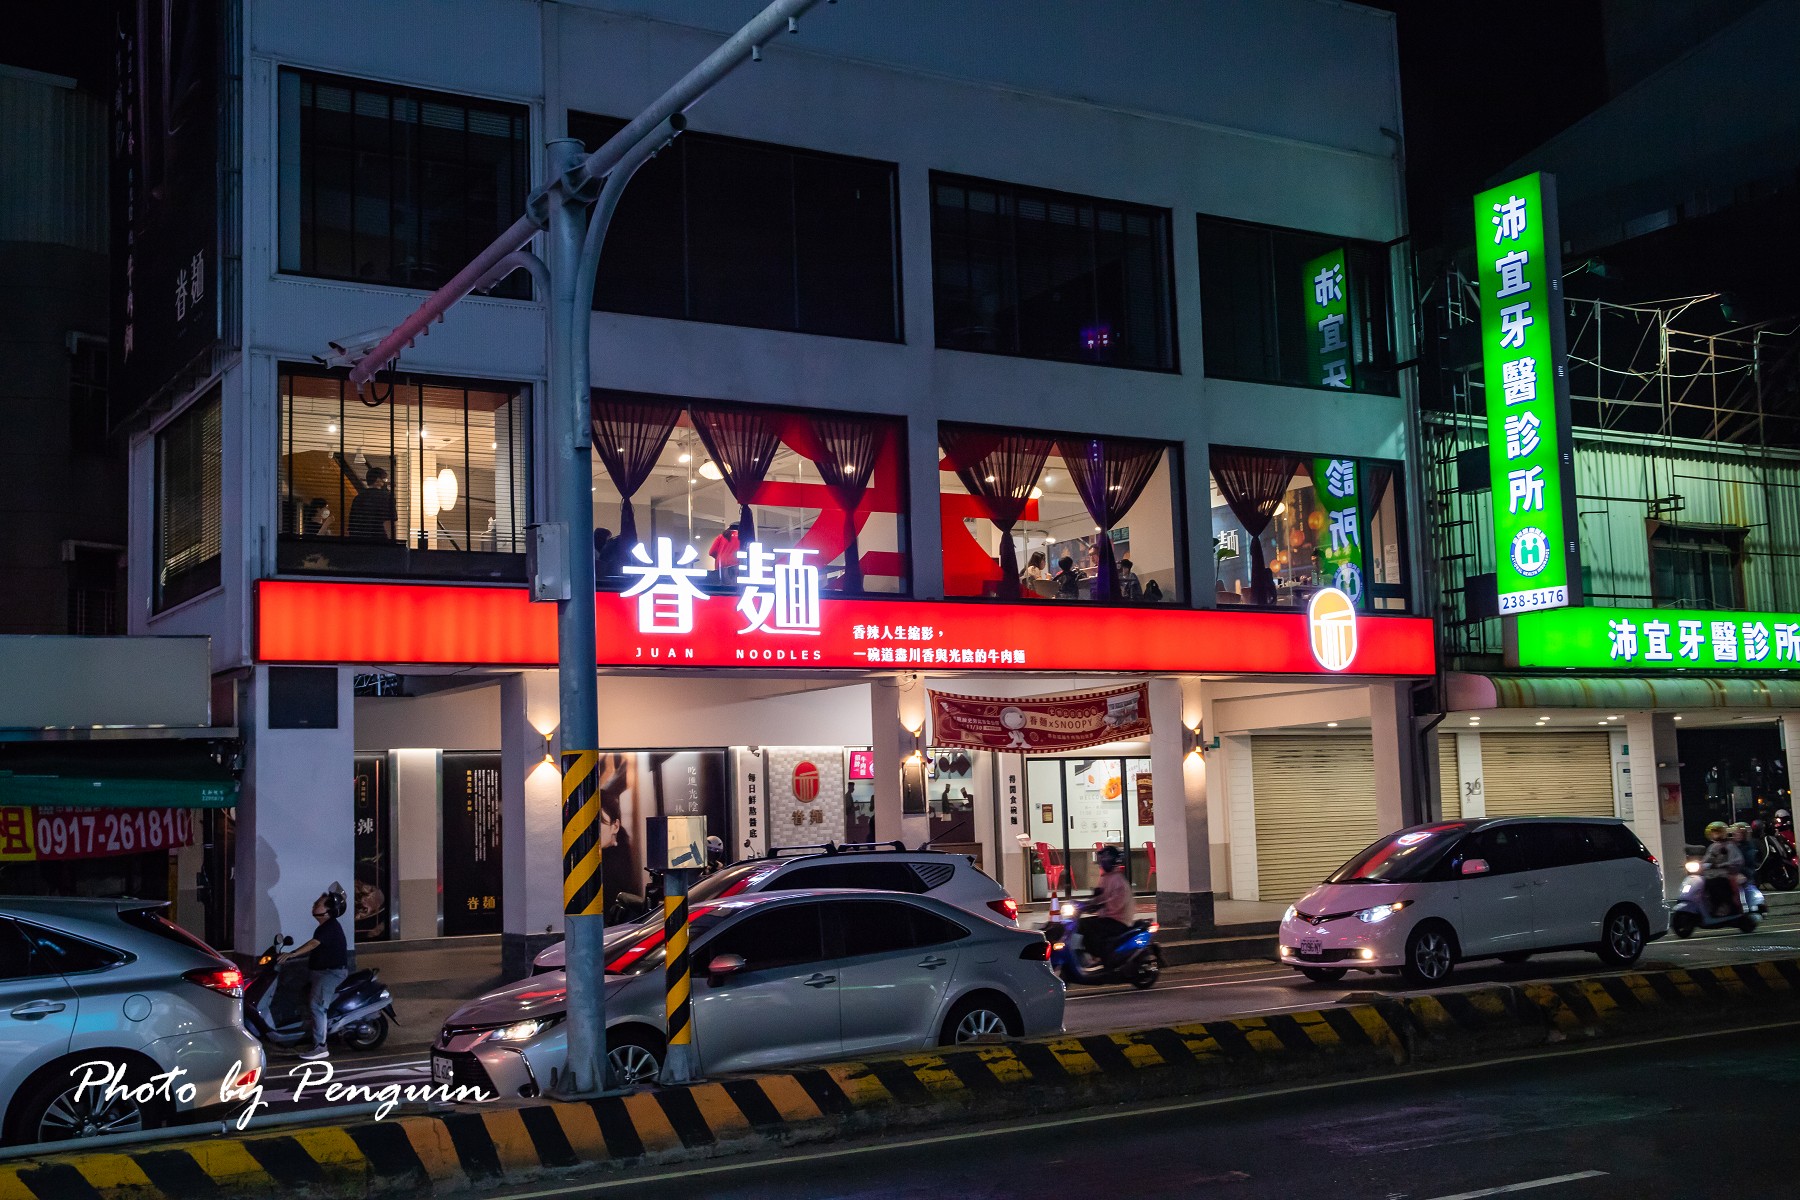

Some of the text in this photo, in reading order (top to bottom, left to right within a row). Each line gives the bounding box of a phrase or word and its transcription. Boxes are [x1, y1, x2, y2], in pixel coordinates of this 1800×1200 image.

[176, 249, 203, 321] 眷麵
[1491, 195, 1546, 514] 沛宜牙醫診所
[620, 536, 821, 635] 眷麵
[1502, 589, 1564, 609] 238-5176
[635, 647, 822, 660] JUAN NOODLES
[853, 647, 1026, 664] 一碗道盡川香與光陰的牛肉麵
[1608, 618, 1800, 662] 沛宜牙醫診所
